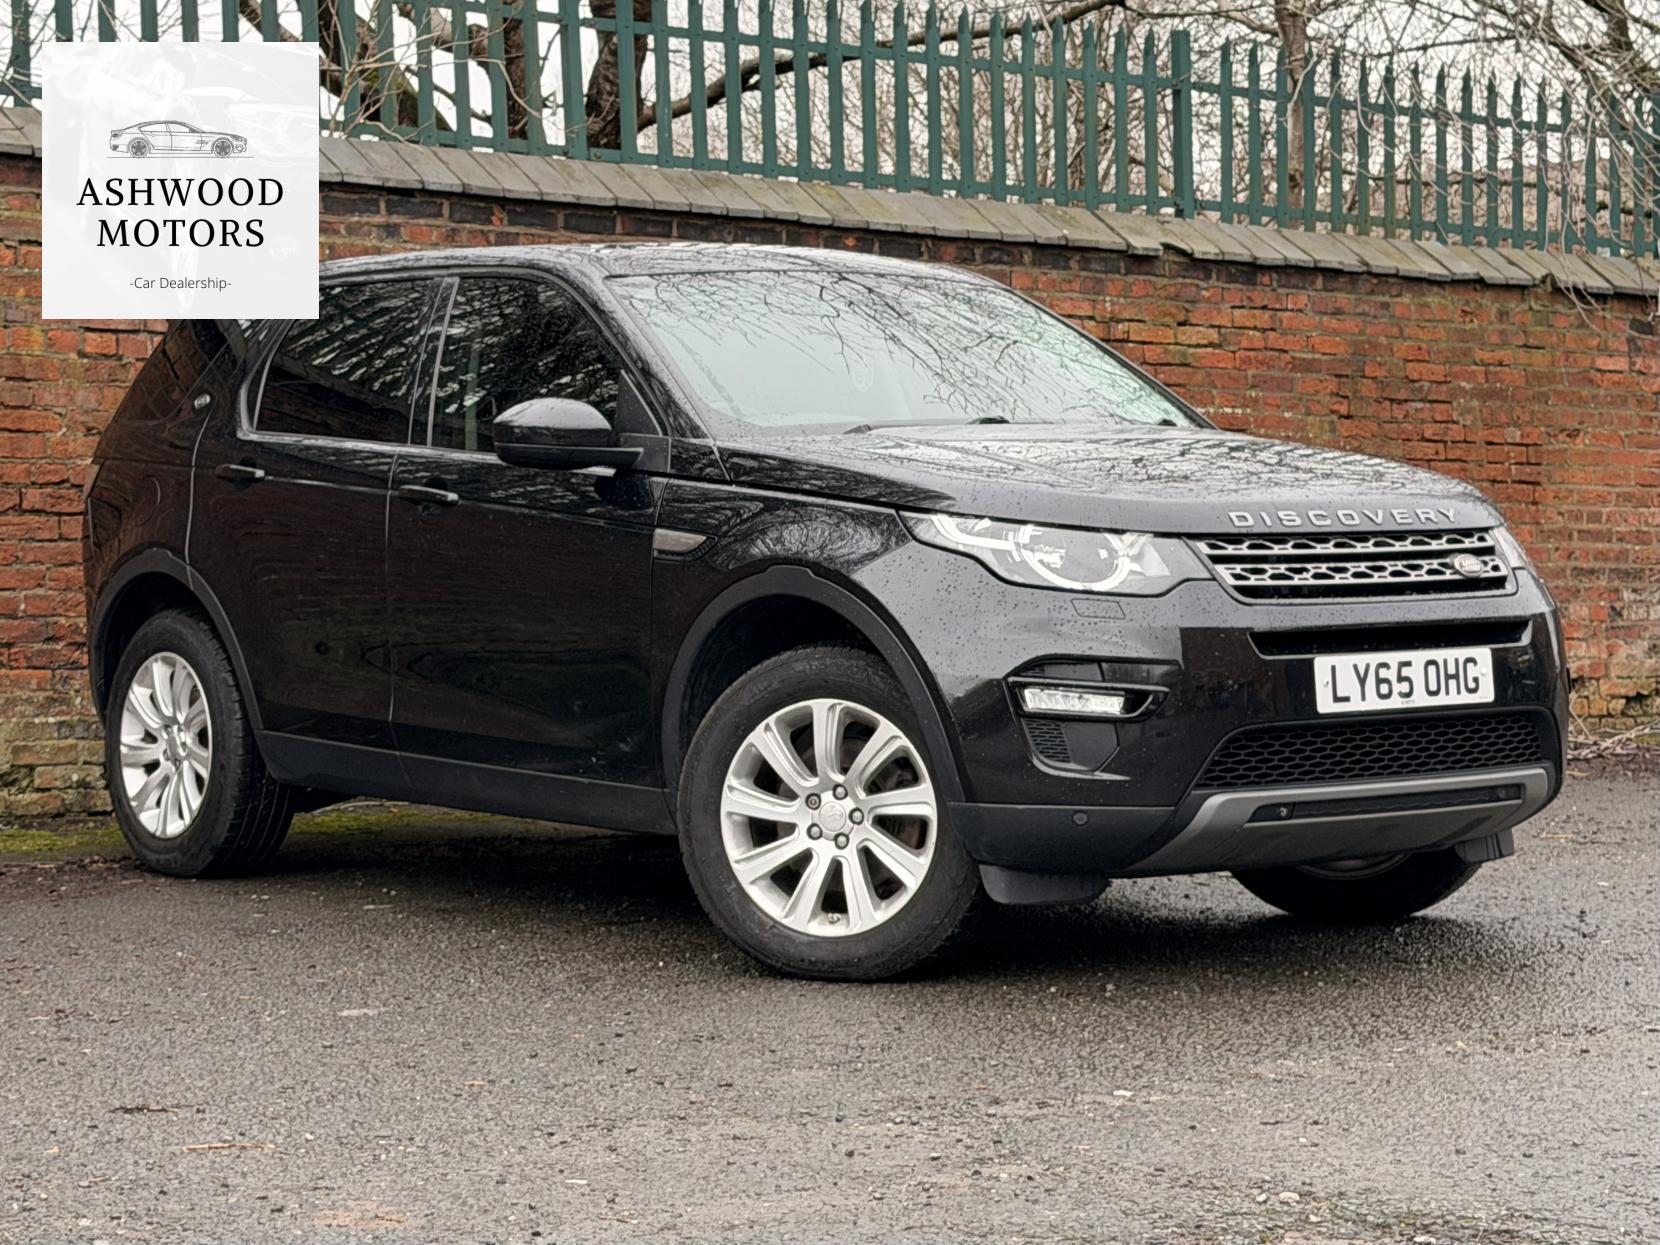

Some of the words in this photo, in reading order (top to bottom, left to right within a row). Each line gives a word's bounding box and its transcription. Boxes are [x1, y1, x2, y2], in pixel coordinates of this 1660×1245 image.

[1227, 508, 1458, 528] DISCOVERY
[1330, 660, 1415, 704] LY65
[1423, 656, 1481, 697] OHG
